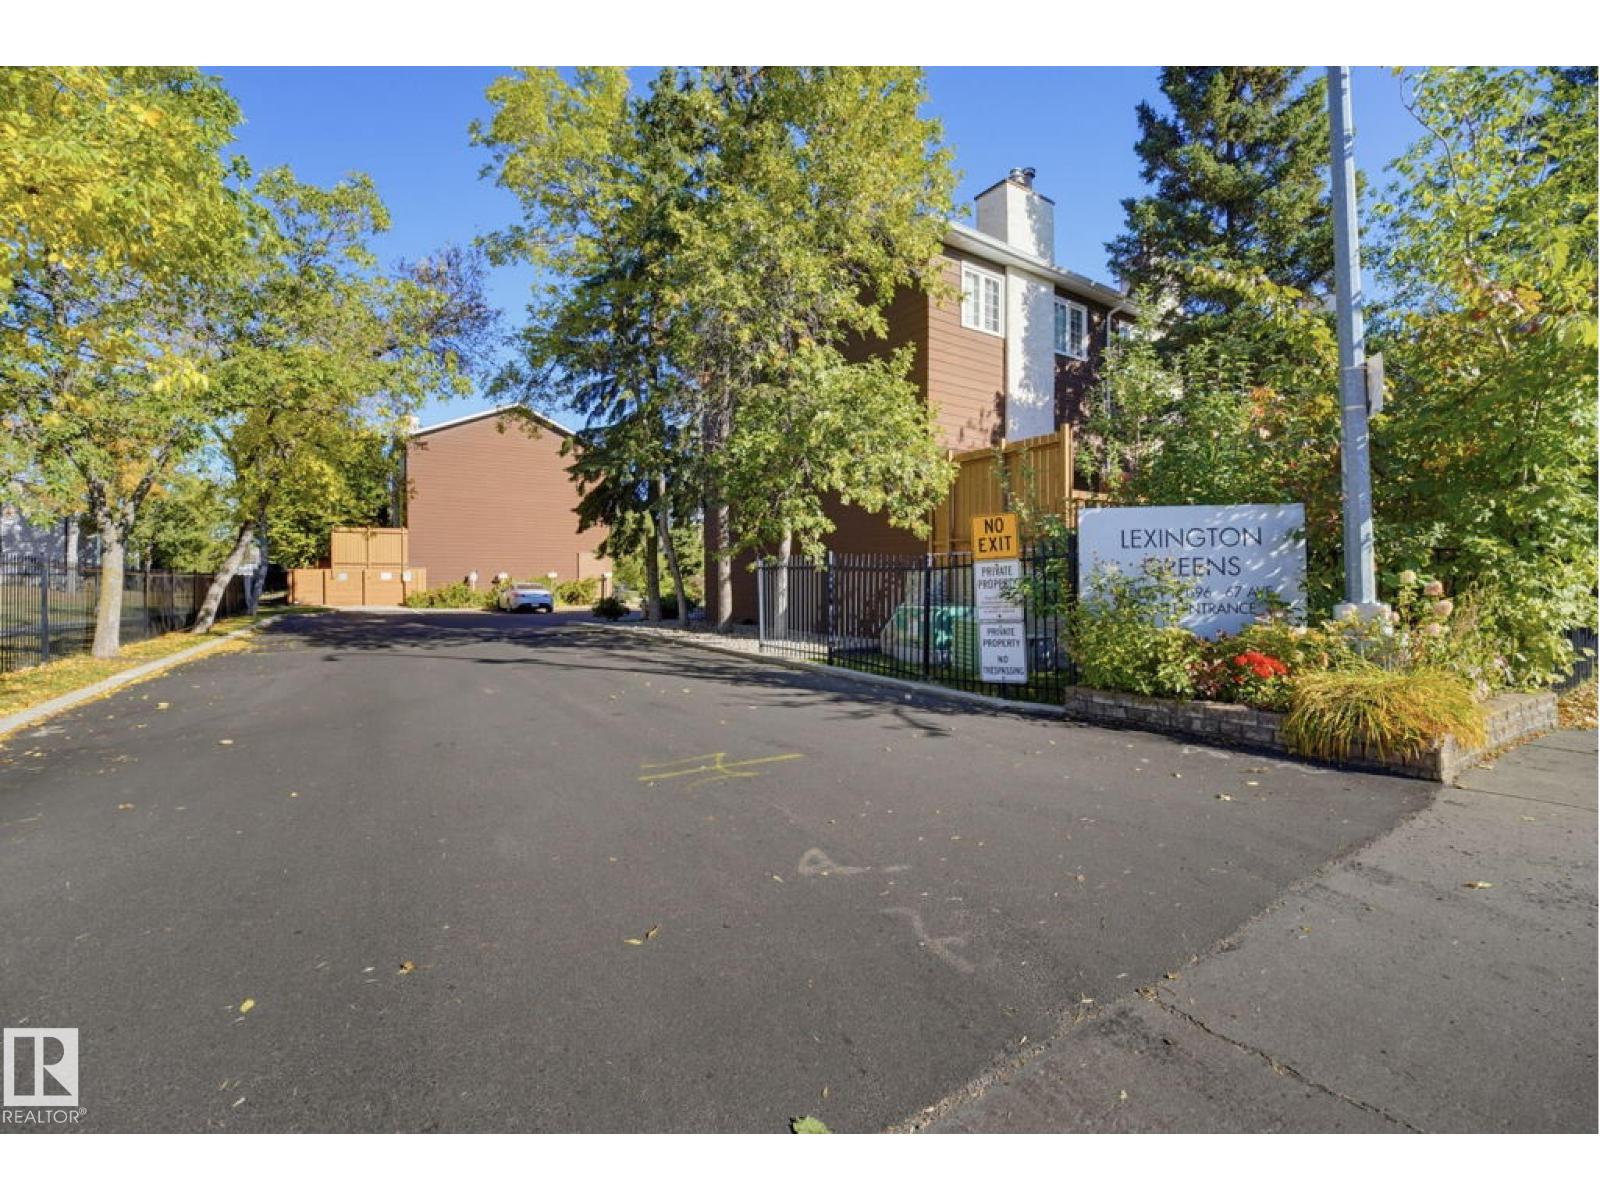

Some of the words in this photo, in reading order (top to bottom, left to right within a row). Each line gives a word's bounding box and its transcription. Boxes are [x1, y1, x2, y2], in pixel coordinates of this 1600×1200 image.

[984, 516, 1005, 533] NO
[978, 536, 1012, 552] EXIT
[1120, 527, 1262, 549] LEXINGTON
[981, 565, 1012, 577] PRIVATE
[1225, 585, 1242, 598] 67
[1183, 602, 1256, 615] NTRANCE
[986, 627, 1016, 637] PRIVATE
[982, 638, 1020, 648] PROPERTY
[997, 655, 1009, 664] NO
